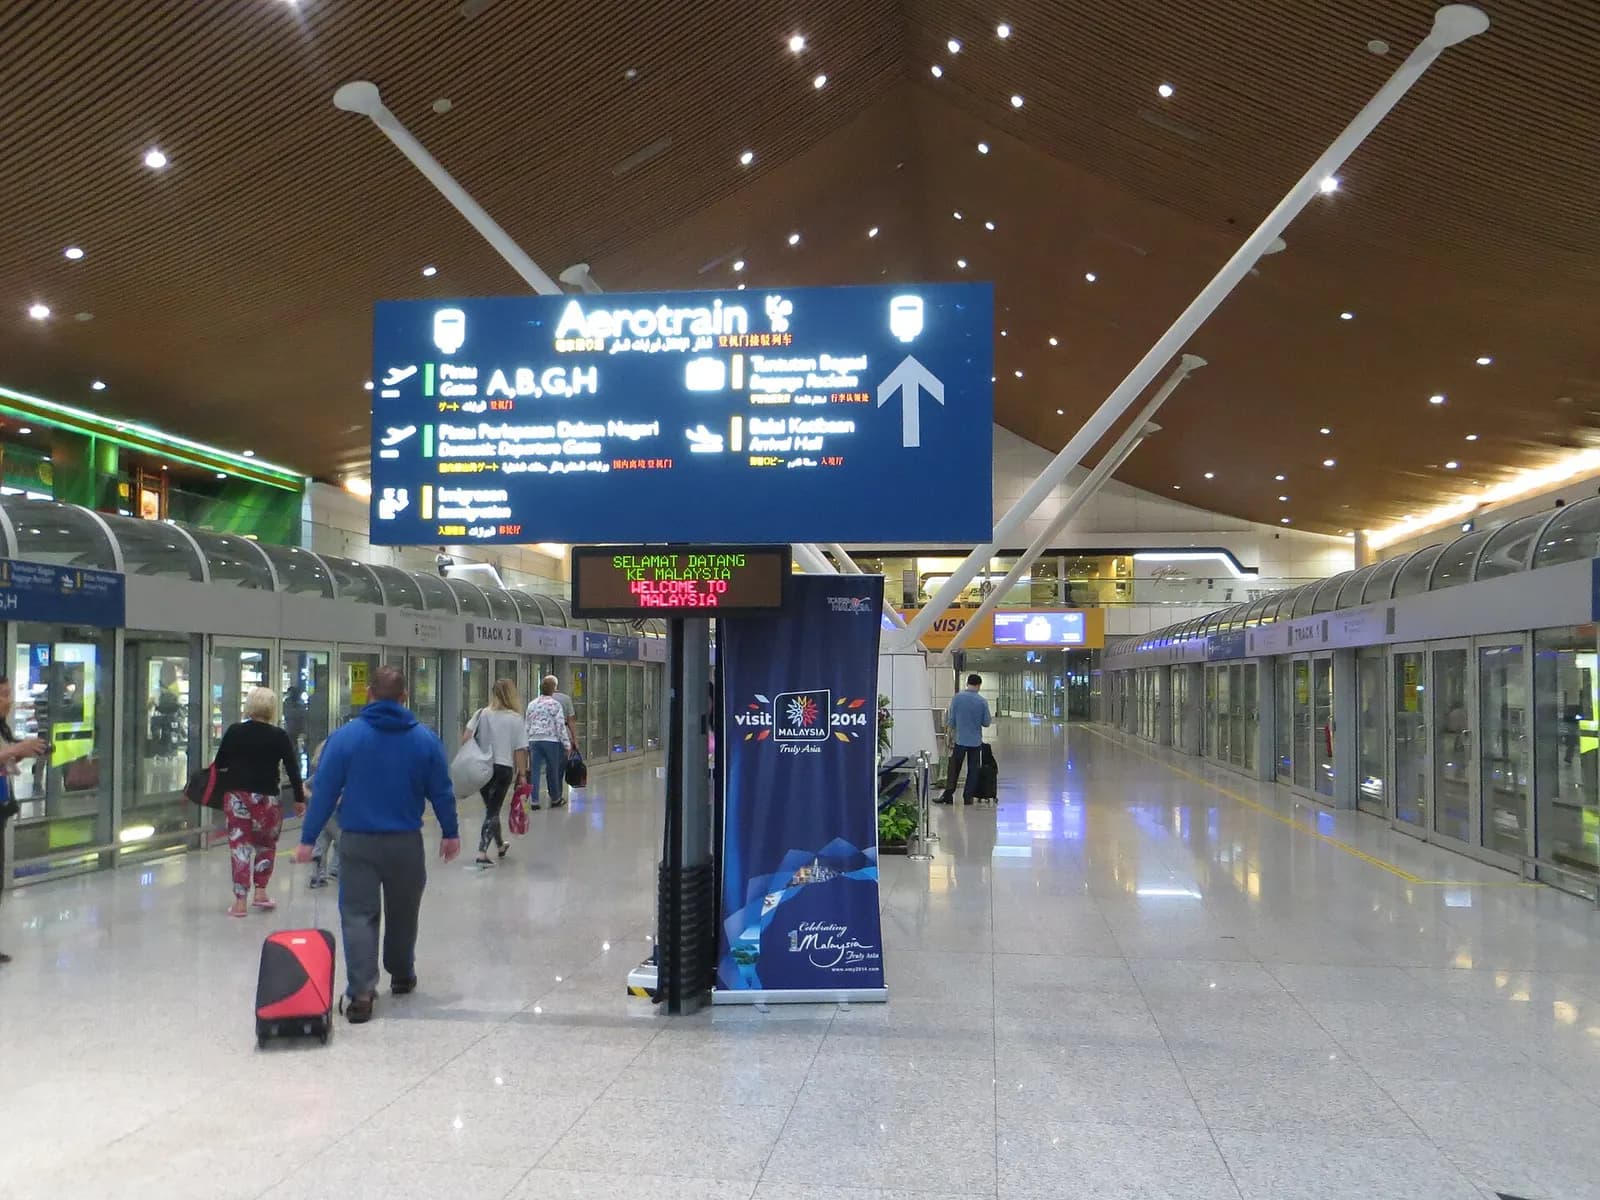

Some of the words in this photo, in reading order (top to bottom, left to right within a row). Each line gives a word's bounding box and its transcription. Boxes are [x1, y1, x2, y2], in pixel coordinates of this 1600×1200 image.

[555, 299, 748, 338] Aerotrain
[613, 555, 678, 568] SELAMAT
[688, 554, 745, 568] DATANG
[627, 569, 644, 580] KE
[655, 568, 731, 580] MALAYSIA
[630, 581, 698, 594] WELCOME
[708, 580, 727, 594] TO
[639, 593, 718, 607] MALAYSIA
[477, 626, 503, 640] TRACK
[506, 628, 511, 640] 2
[1295, 625, 1314, 640] TRACK
[735, 712, 772, 726] visit
[831, 713, 867, 726] 2014
[778, 728, 826, 737] MALAYSIA
[780, 744, 800, 755] Truly
[800, 745, 822, 753] Asia
[799, 921, 847, 937] Celebrating
